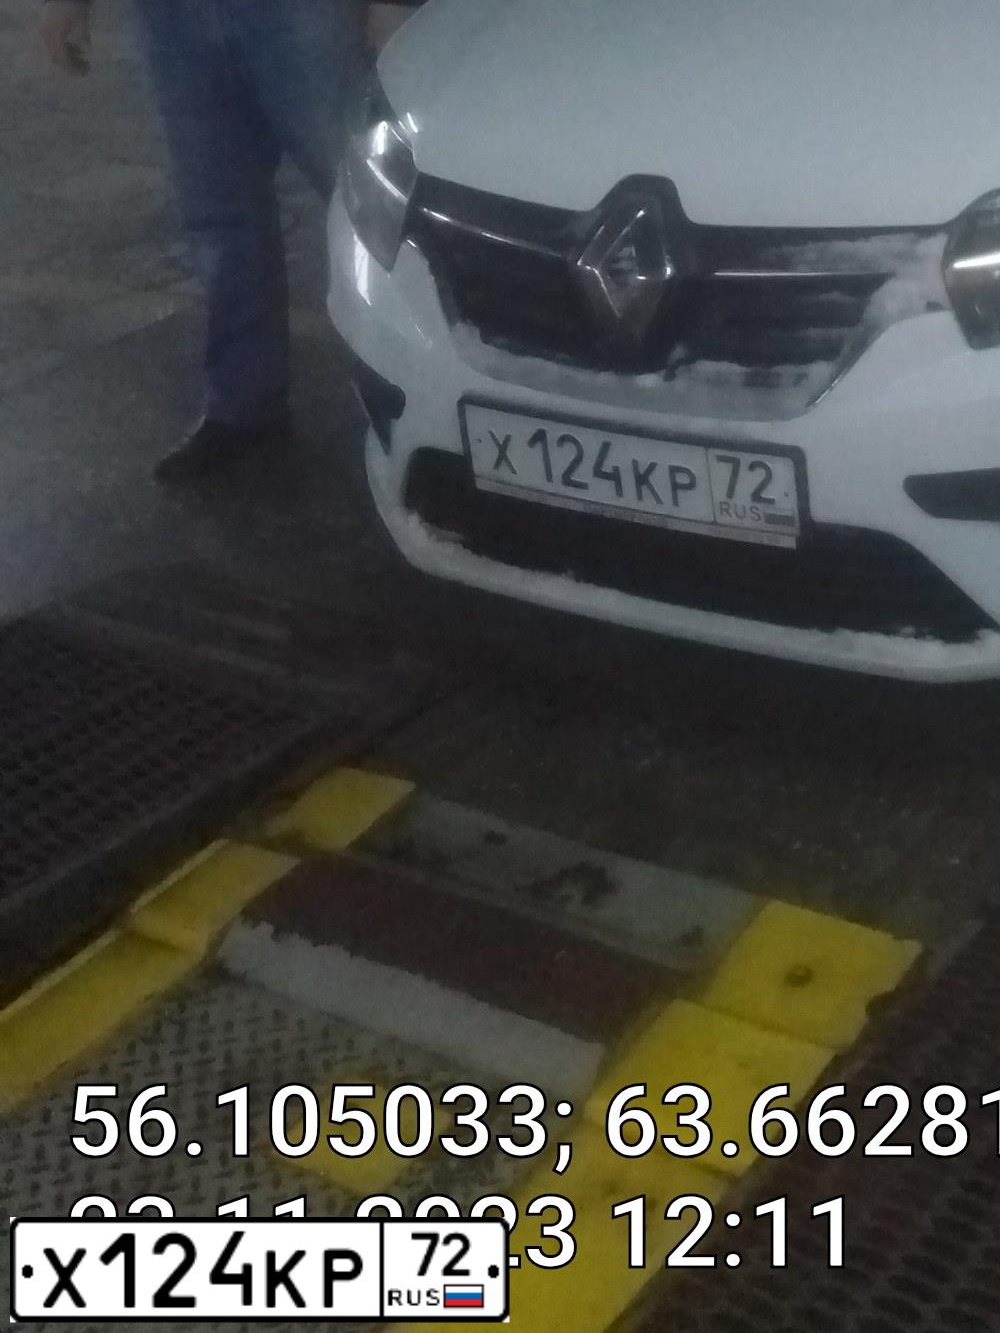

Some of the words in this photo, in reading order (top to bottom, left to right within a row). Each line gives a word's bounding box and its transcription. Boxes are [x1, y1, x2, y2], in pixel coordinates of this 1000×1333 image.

[488, 427, 698, 507] Х124КР
[715, 455, 776, 505] 72
[719, 500, 762, 523] RUS
